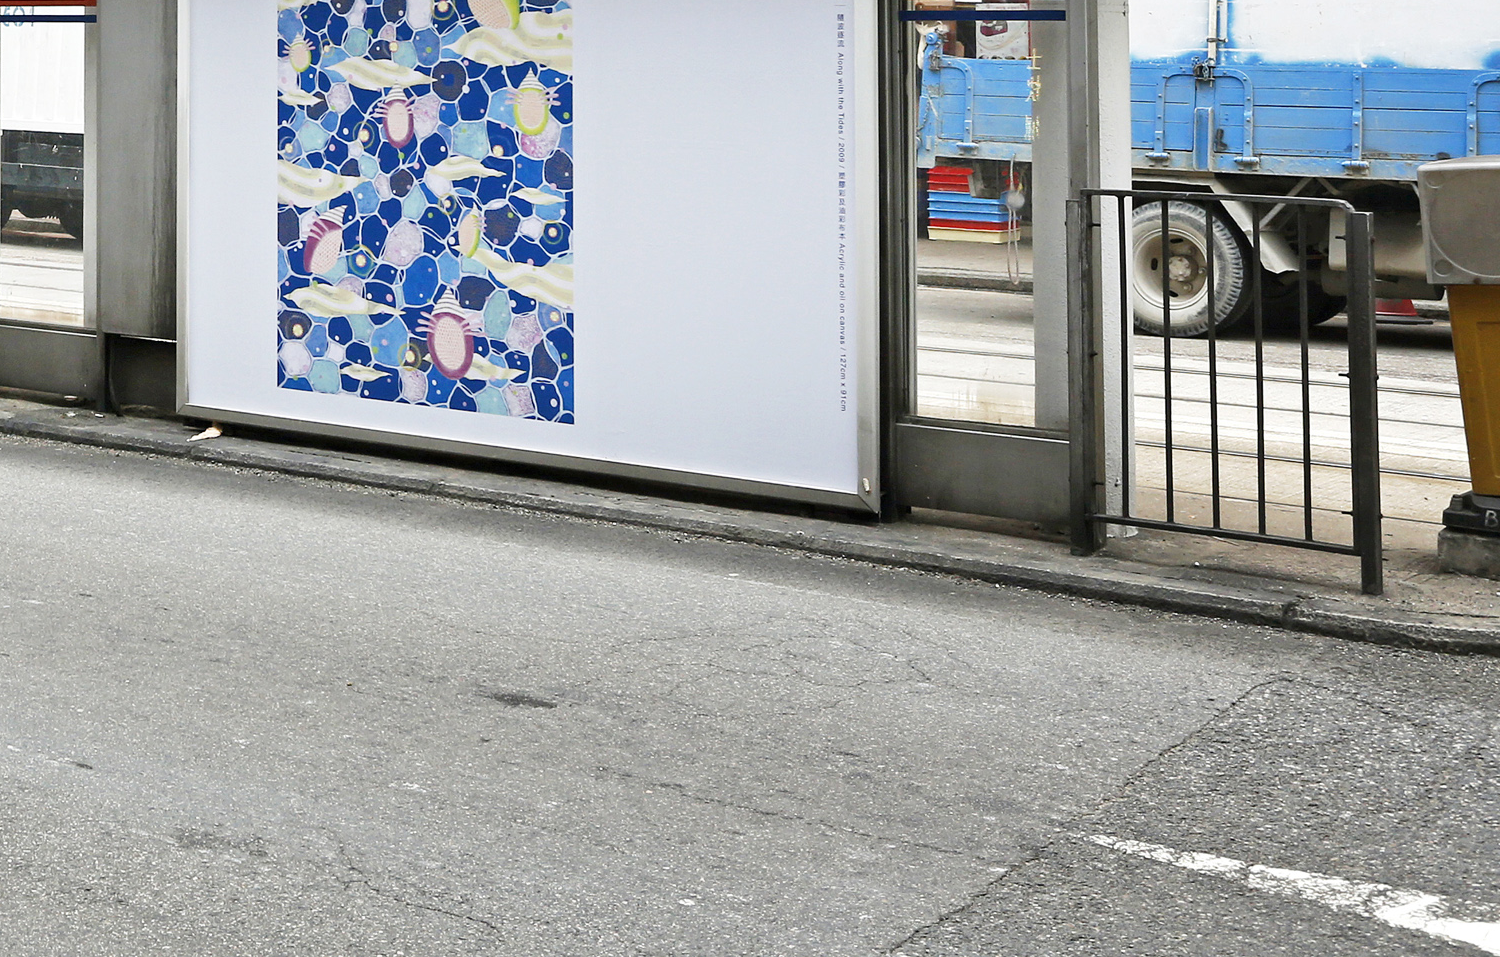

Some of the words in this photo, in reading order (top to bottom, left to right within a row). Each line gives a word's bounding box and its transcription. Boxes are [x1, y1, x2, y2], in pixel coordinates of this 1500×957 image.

[836, 53, 845, 76] Along
[837, 78, 845, 94] with
[837, 96, 845, 110] the
[838, 112, 846, 135] Tides
[838, 142, 846, 163] 2009
[838, 242, 846, 271] Acrylic
[838, 273, 846, 288] and
[838, 290, 846, 301] oil
[839, 303, 846, 314] on
[839, 353, 847, 379] 127cm
